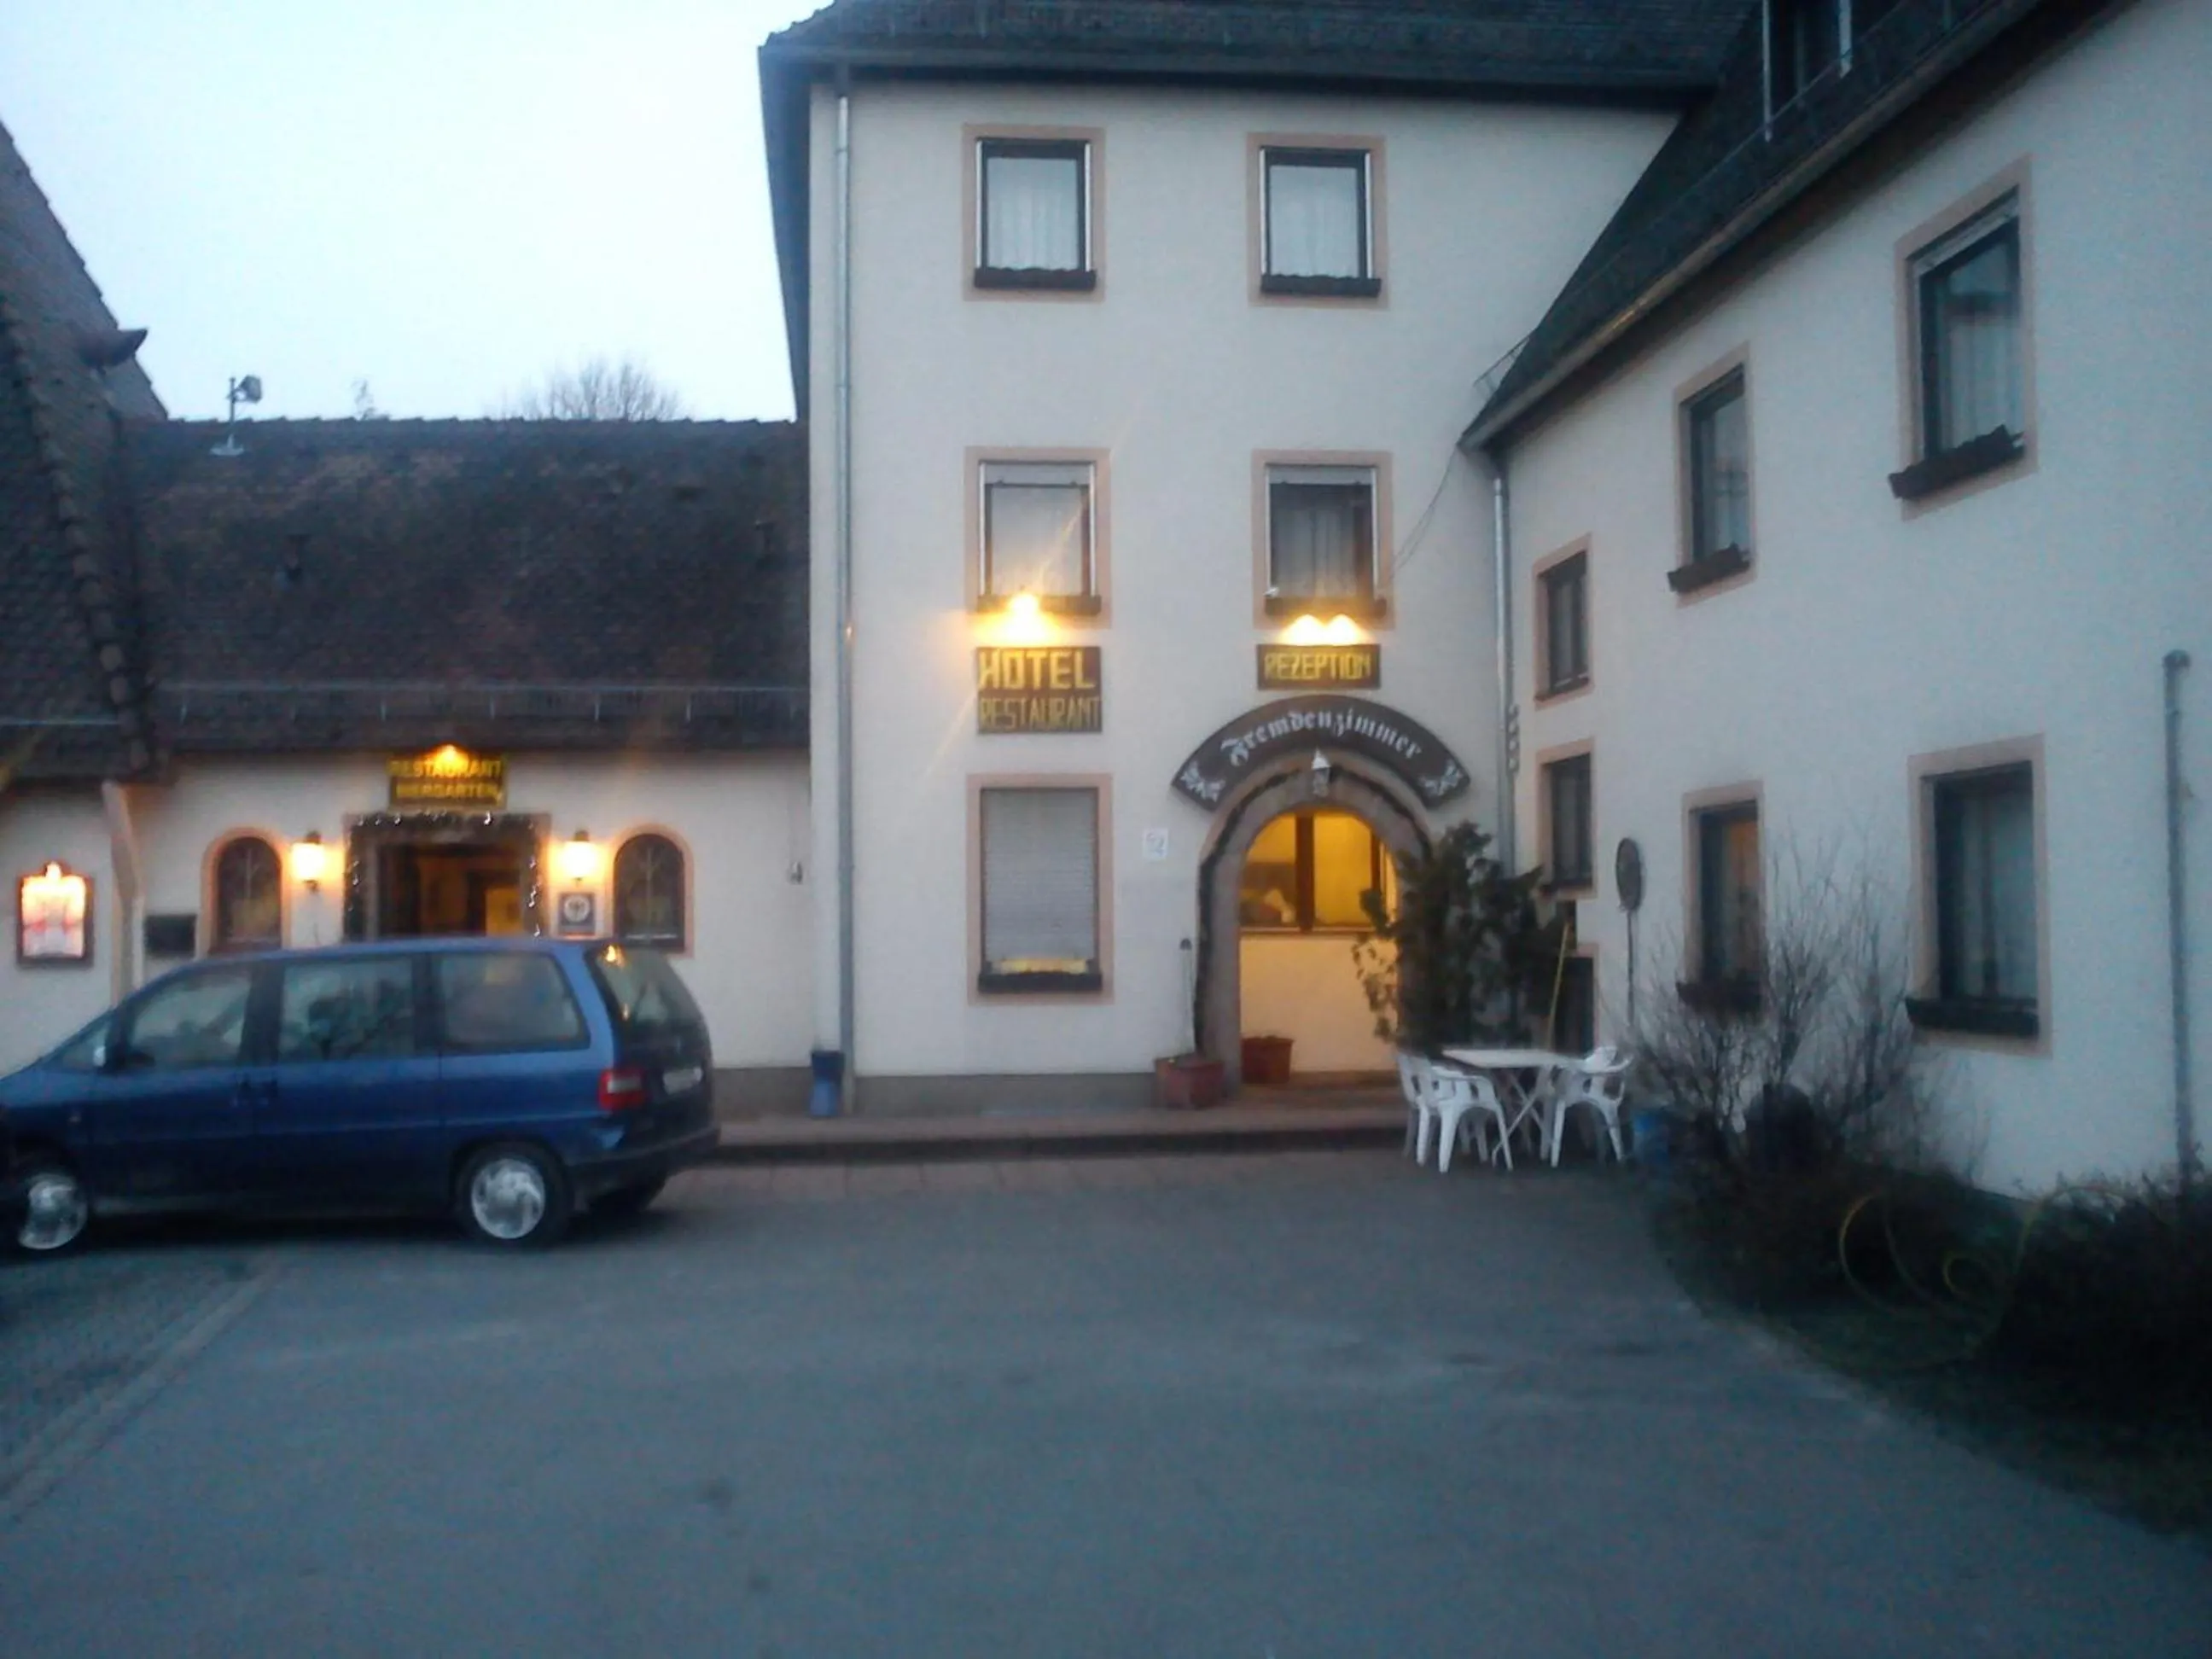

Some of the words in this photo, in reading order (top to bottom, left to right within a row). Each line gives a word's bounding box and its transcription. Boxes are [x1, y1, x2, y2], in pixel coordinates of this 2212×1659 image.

[978, 649, 1096, 690] HOTEL
[1264, 652, 1371, 680] REZEPTION
[981, 696, 1102, 730] RESTAURANT
[1220, 707, 1422, 766] Fremdenzimmer
